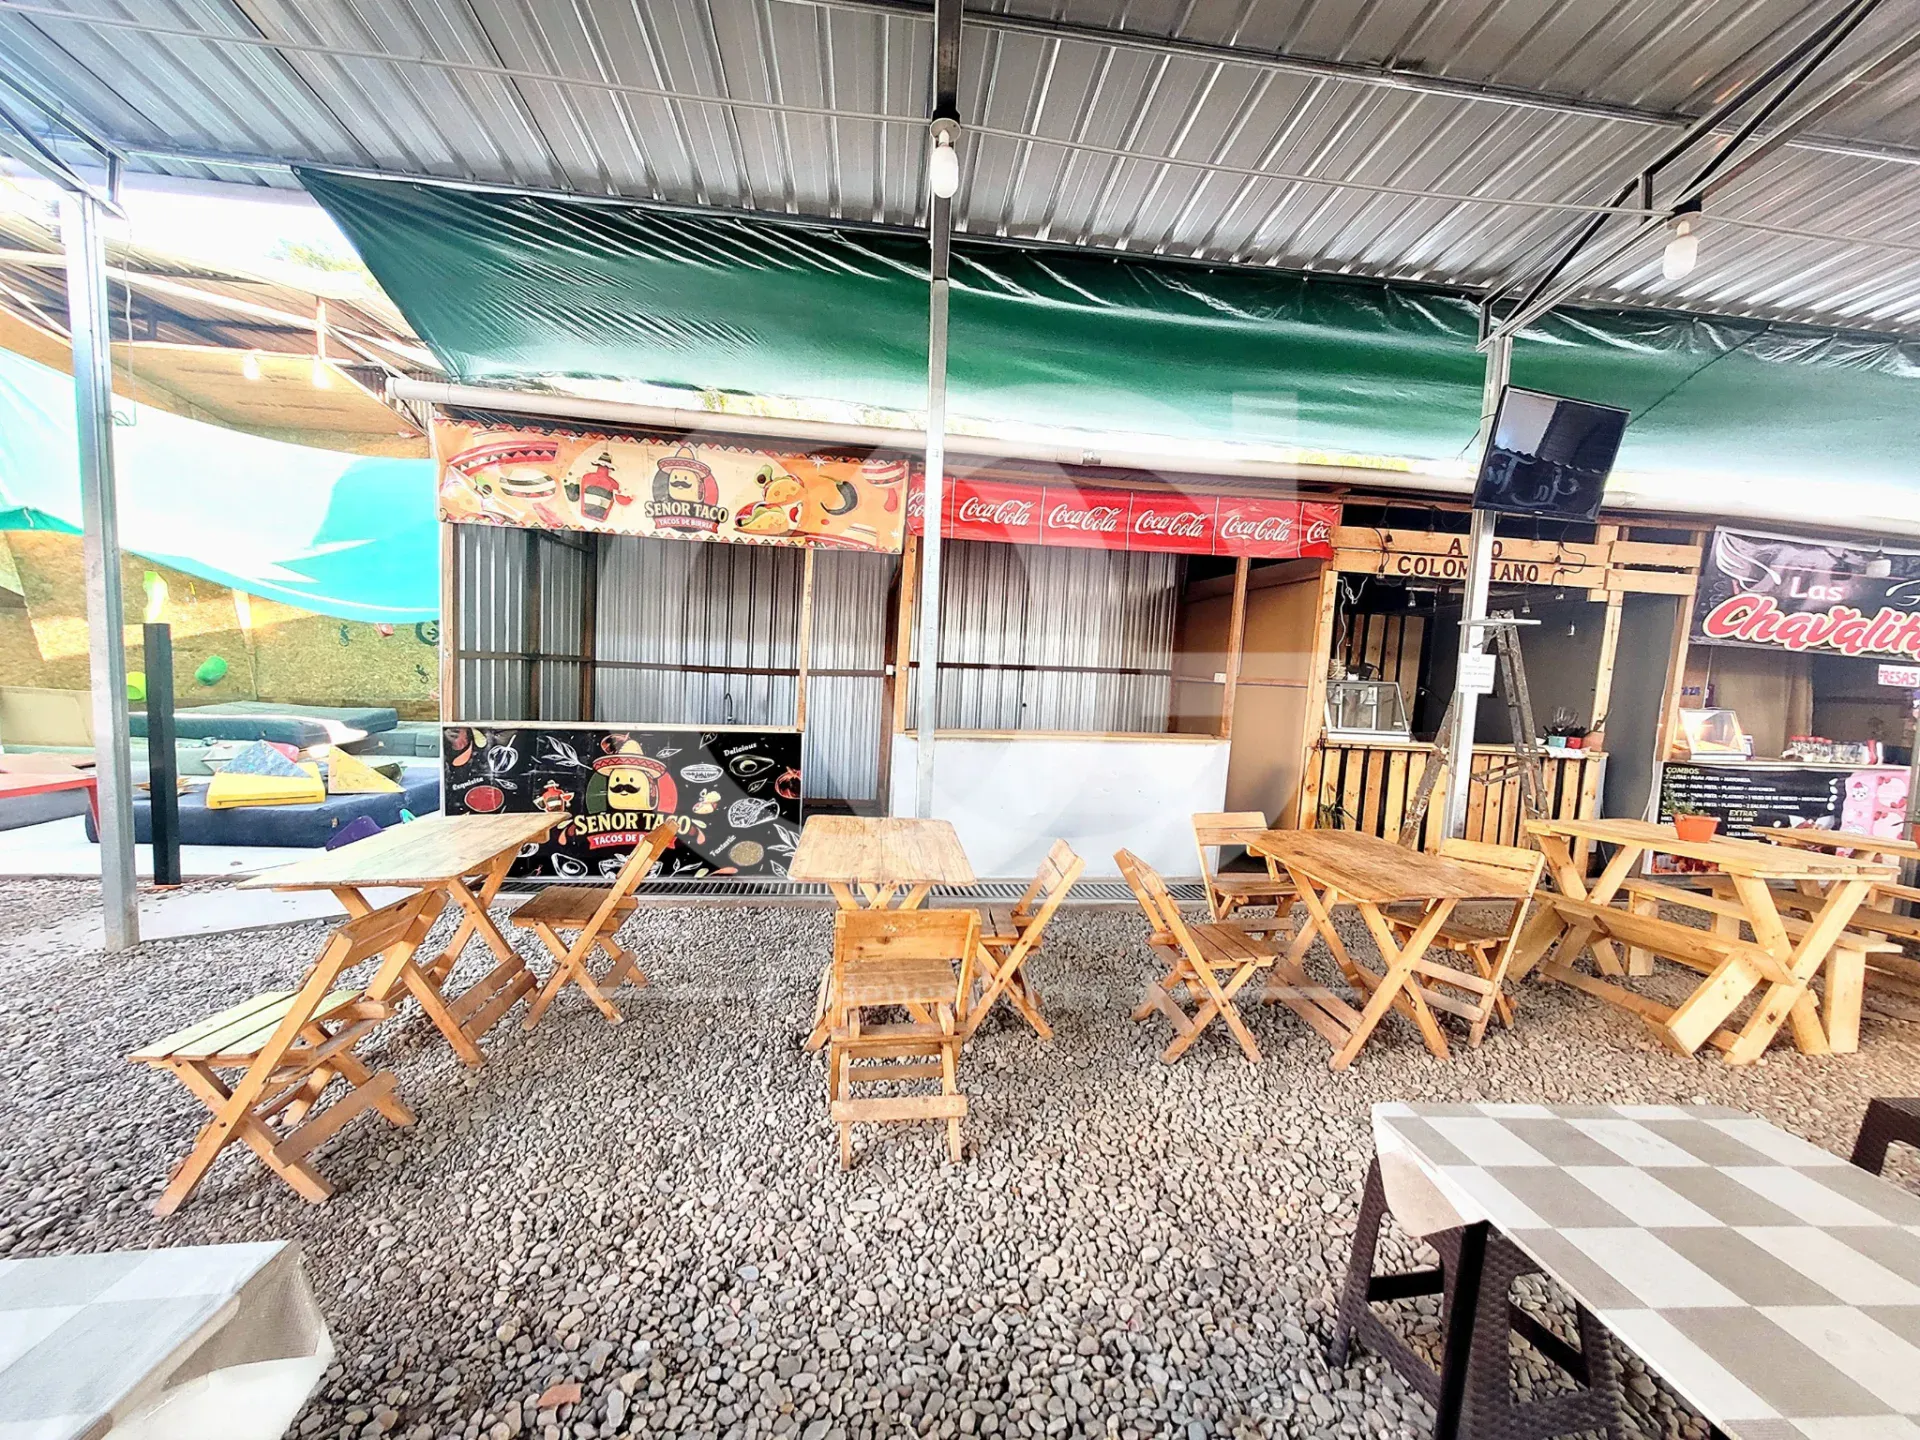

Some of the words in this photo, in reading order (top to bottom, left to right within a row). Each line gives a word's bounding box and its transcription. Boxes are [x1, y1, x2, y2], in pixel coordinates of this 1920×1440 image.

[645, 500, 690, 517] SEÑOR
[693, 504, 728, 523] TACO
[959, 497, 1036, 526] Coca-Cola
[1048, 503, 1123, 532] Coca-Cola
[1135, 510, 1208, 538] Coca-Cola
[1221, 514, 1294, 542] Coca-Cola
[1397, 556, 1539, 582] COLOMIANO
[1790, 576, 1844, 600] Las
[723, 742, 757, 757] Delicious
[1666, 766, 1700, 775] COMBOS
[574, 812, 638, 836] SEÑOR
[1728, 809, 1758, 817] EXTRAS
[594, 834, 623, 845] TACOS
[625, 834, 637, 843] DE
